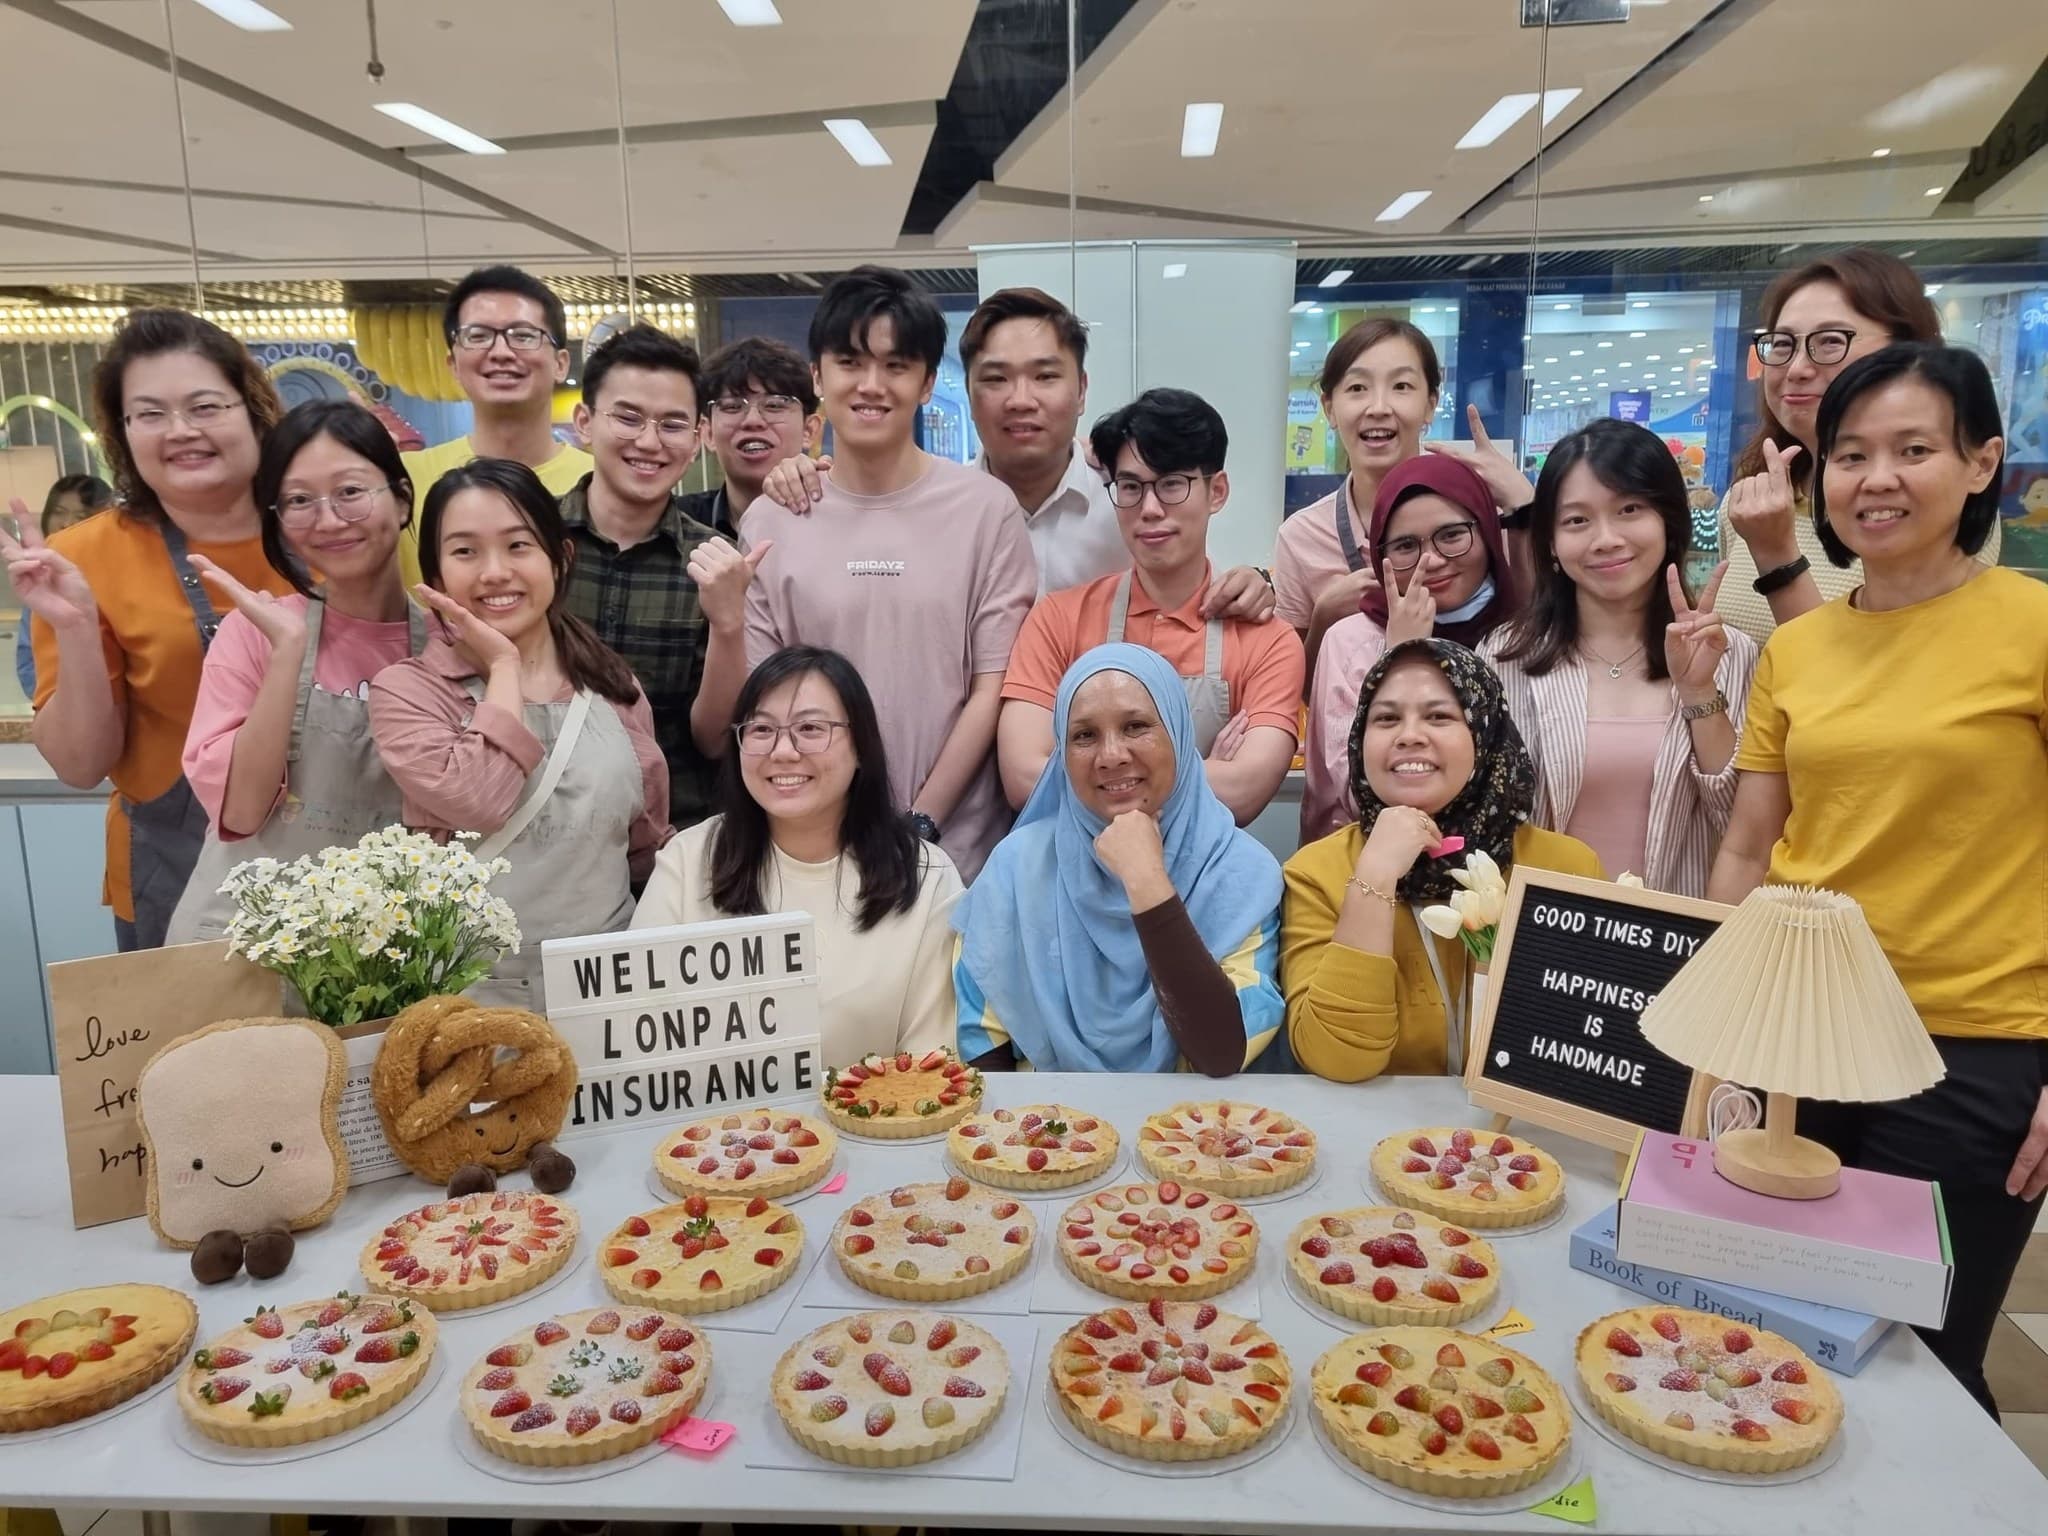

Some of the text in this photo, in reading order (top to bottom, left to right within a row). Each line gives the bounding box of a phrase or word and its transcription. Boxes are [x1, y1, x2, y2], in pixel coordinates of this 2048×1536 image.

[847, 560, 905, 570] FRIDAYZ
[1533, 905, 1700, 957] GOOD TIMES DIY
[573, 932, 802, 999] WELCOME
[76, 1016, 150, 1061] love
[604, 997, 777, 1059] LONPAC
[1584, 1015, 1603, 1037] IS
[357, 1076, 370, 1085] sa
[1531, 1035, 1645, 1086] HANDMADE
[94, 1079, 138, 1117] fre
[572, 1050, 812, 1125] INSURANCE
[99, 1142, 147, 1176] hap
[1588, 1248, 1763, 1332] Book of Bread
[1551, 1495, 1580, 1507] die
